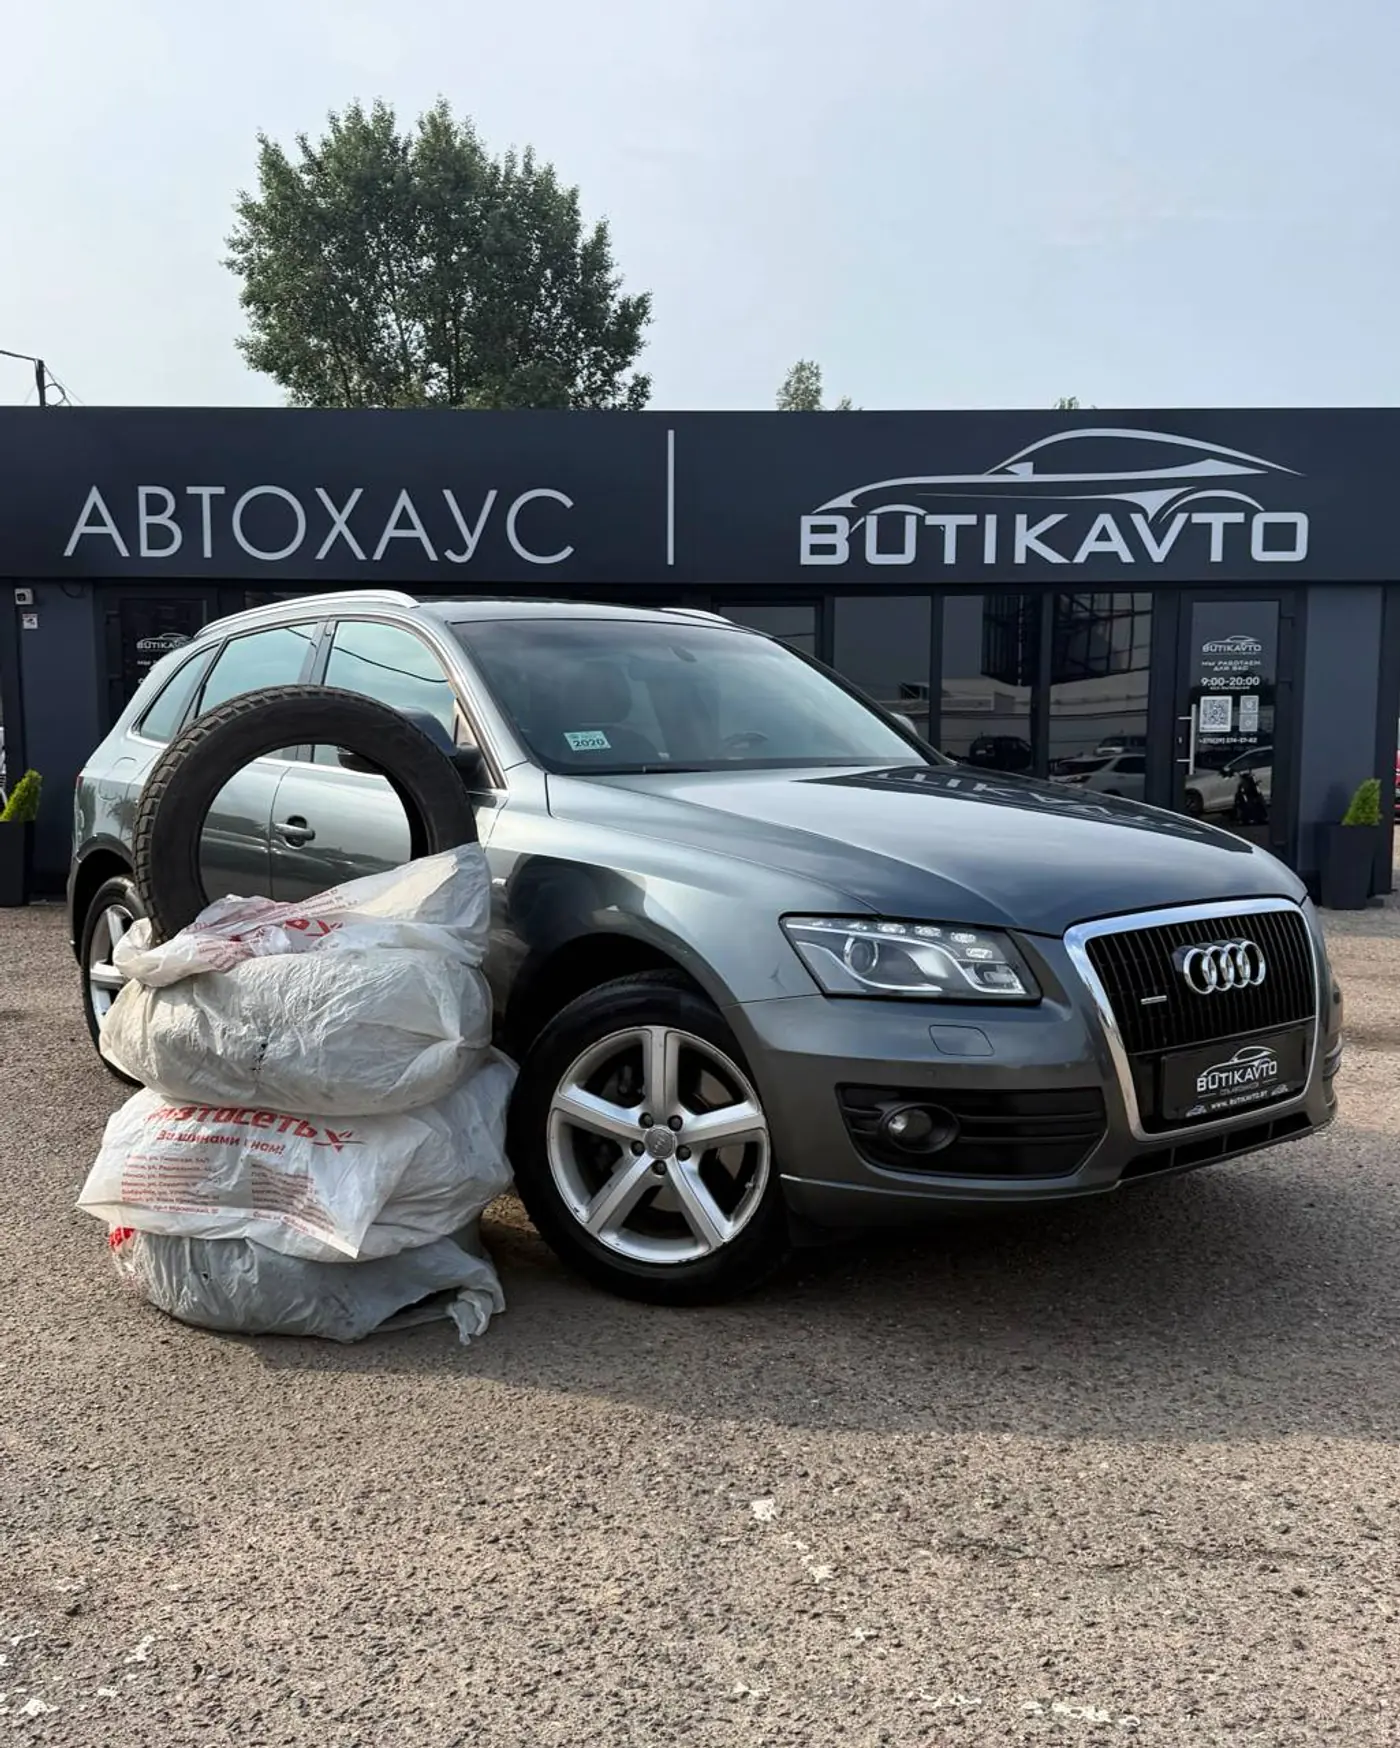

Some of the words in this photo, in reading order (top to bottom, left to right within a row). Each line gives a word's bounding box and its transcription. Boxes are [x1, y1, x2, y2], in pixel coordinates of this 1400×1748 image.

[64, 484, 575, 565] АВТОХАУС
[799, 510, 1309, 567] BUTIKAVTO
[1202, 644, 1262, 652] BUTIKAVTO
[1201, 676, 1260, 686] 9:00-20:00
[573, 739, 605, 747] 2020
[1197, 1060, 1277, 1092] BUTIKAVTO
